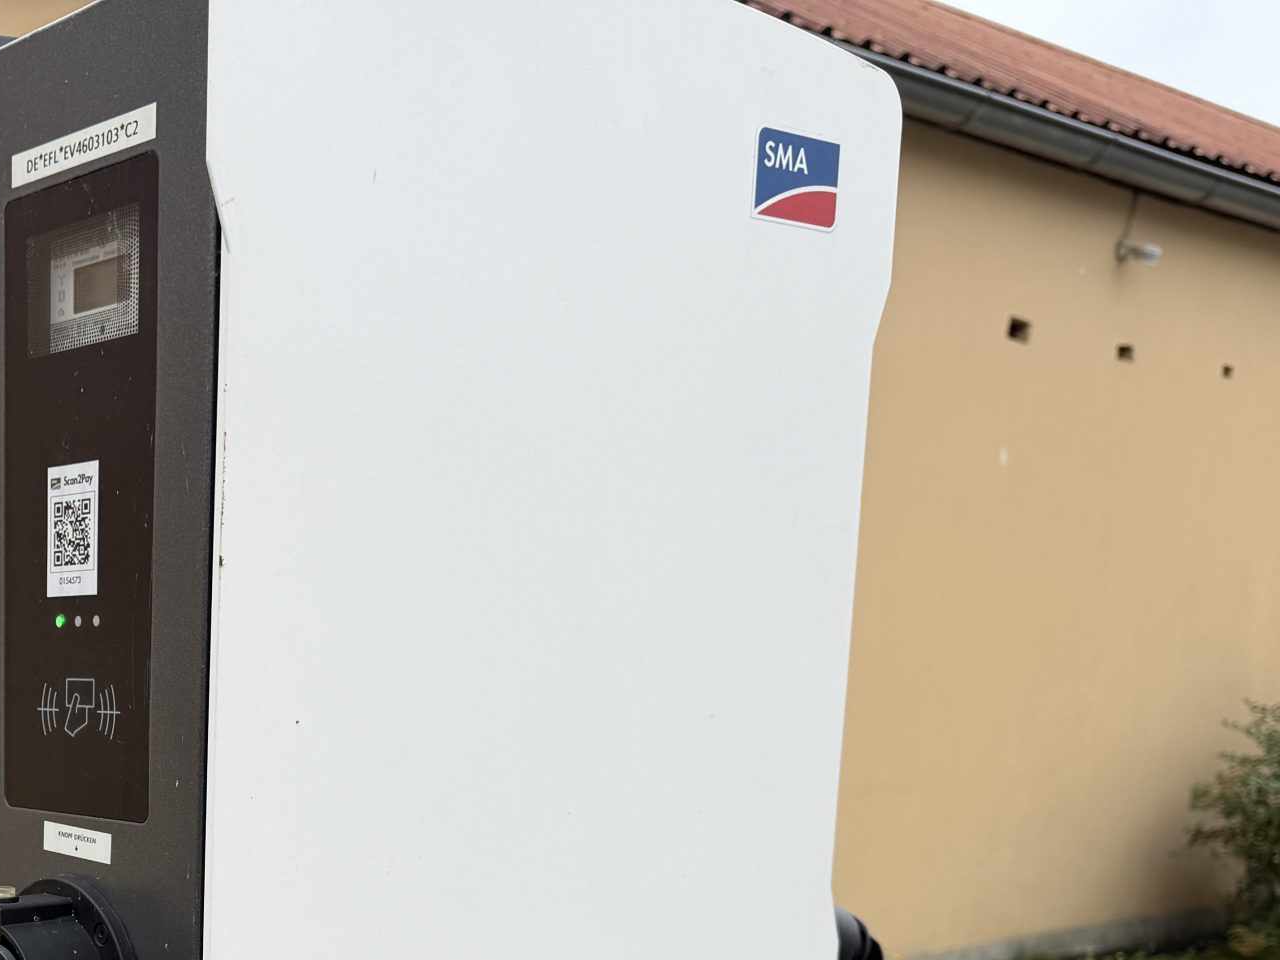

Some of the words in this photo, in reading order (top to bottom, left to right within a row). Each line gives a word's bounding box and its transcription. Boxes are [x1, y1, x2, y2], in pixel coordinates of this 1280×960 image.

[764, 140, 808, 175] SMA
[63, 474, 93, 486] Scan2Pay
[58, 831, 73, 839] KNOPF
[73, 833, 97, 844] DRÜCKEN
